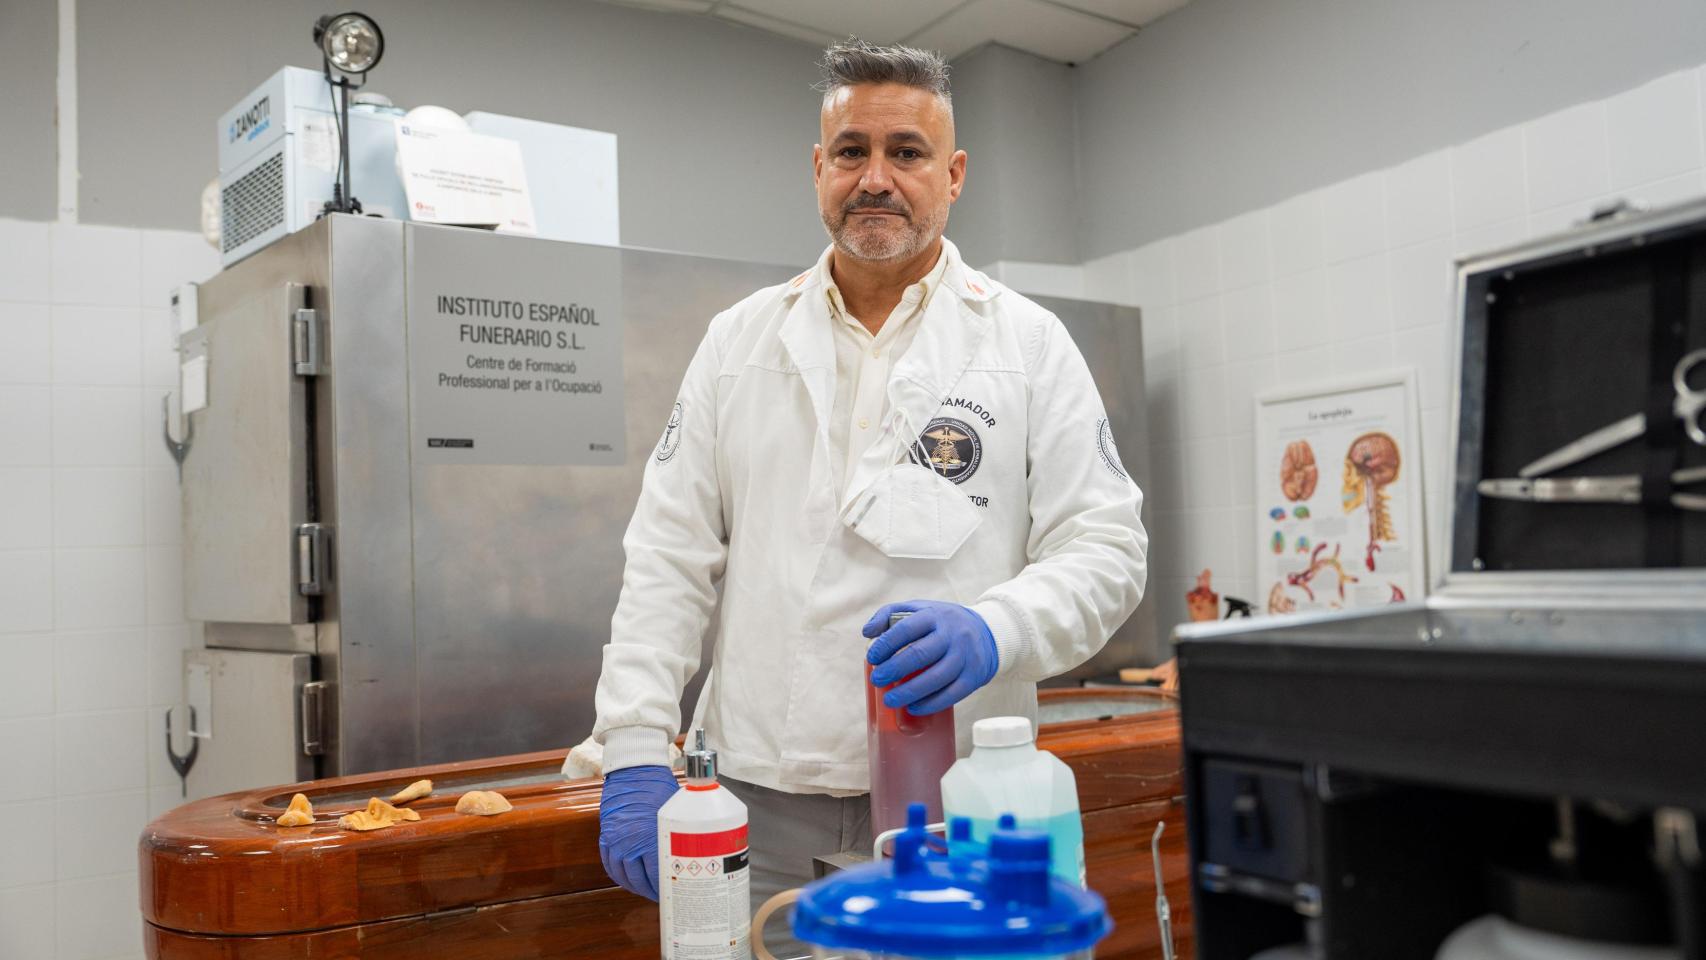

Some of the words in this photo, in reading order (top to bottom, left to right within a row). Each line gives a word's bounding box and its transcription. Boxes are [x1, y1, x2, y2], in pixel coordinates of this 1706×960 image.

[236, 95, 270, 139] ZANOTTI
[437, 295, 524, 320] INSTITUTO
[529, 303, 600, 326] ESPAÑOL
[459, 324, 552, 348] FUNERARIO
[556, 331, 586, 350] S.L.
[466, 354, 505, 370] Centre
[508, 357, 522, 371] de
[525, 358, 577, 374] Formació
[438, 372, 510, 390] Professional
[513, 378, 531, 392] per
[535, 381, 542, 391] a
[545, 378, 602, 395] l'Ocupació
[942, 397, 996, 428] AMADOR
[968, 495, 988, 508] TOR
